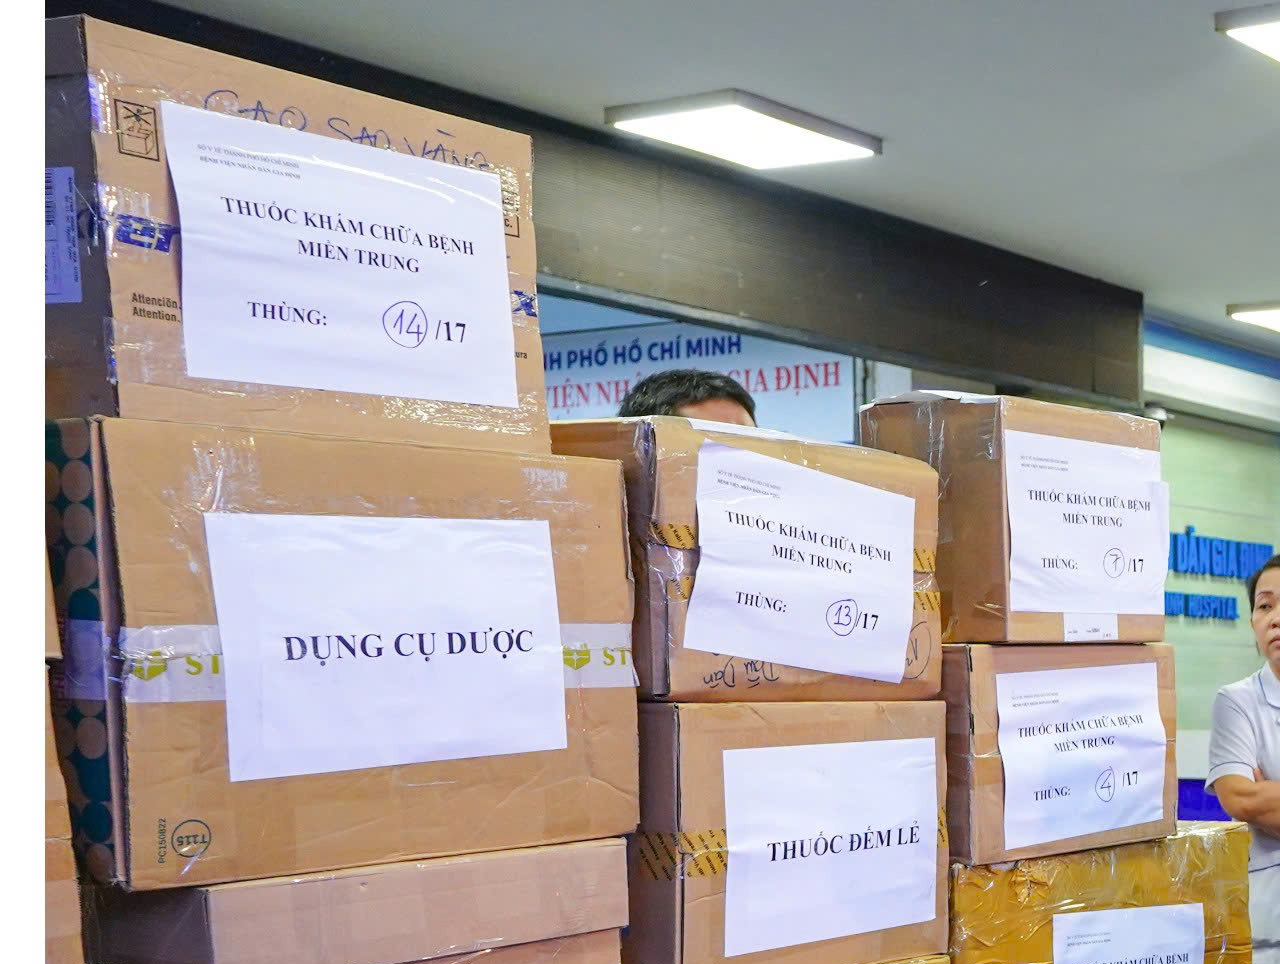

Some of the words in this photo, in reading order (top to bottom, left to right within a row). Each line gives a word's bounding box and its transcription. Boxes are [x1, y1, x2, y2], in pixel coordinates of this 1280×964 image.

[221, 196, 297, 225] THUỐC
[303, 211, 364, 236] KHÁM
[370, 224, 423, 247] CHỮA
[428, 233, 475, 256] BỆNH
[298, 239, 349, 262] MIỀN
[354, 248, 420, 273] TRUNG
[248, 301, 328, 326] THÙNG:
[393, 309, 423, 342] 14
[435, 320, 466, 343] /17
[567, 341, 608, 369] PHỐ
[613, 339, 642, 365] HỒ
[647, 334, 682, 361] CHÍ
[687, 335, 742, 358] MINH
[775, 361, 841, 398] ĐỊNH
[1027, 489, 1064, 503] THUỐC
[1066, 492, 1097, 506] KHÁM
[1098, 496, 1125, 509] CHỮA
[1127, 500, 1151, 512] BỆNH
[725, 510, 775, 533] THUỐC
[779, 525, 817, 545] KHÁM
[821, 535, 856, 553] CHỮA
[860, 544, 892, 562] BỆNH
[1062, 512, 1088, 525] MIỀN
[1090, 515, 1123, 528] TRUNG
[771, 544, 805, 564] MIỀN
[809, 553, 852, 574] TRUNG
[1041, 555, 1079, 570] THÙNG:
[1127, 558, 1144, 573] /17
[735, 590, 787, 613] THÙNG:
[834, 604, 852, 626] 13
[855, 611, 879, 631] /17
[283, 633, 384, 667] DỤNG
[394, 631, 437, 662] CỤ
[446, 627, 534, 659] DƯỢC
[1018, 722, 1053, 738] THUỐC
[1055, 718, 1086, 734] KHÁM
[1087, 715, 1116, 730] CHỮA
[1117, 714, 1144, 729] BỆNH
[1054, 739, 1079, 754] MIỀN
[1082, 735, 1115, 750] TRUNG
[1034, 786, 1071, 801] THÙNG:
[1122, 771, 1139, 787] /17
[767, 830, 843, 862] THUỐC
[849, 825, 892, 851] ĐẾM
[897, 821, 921, 846] LẺ
